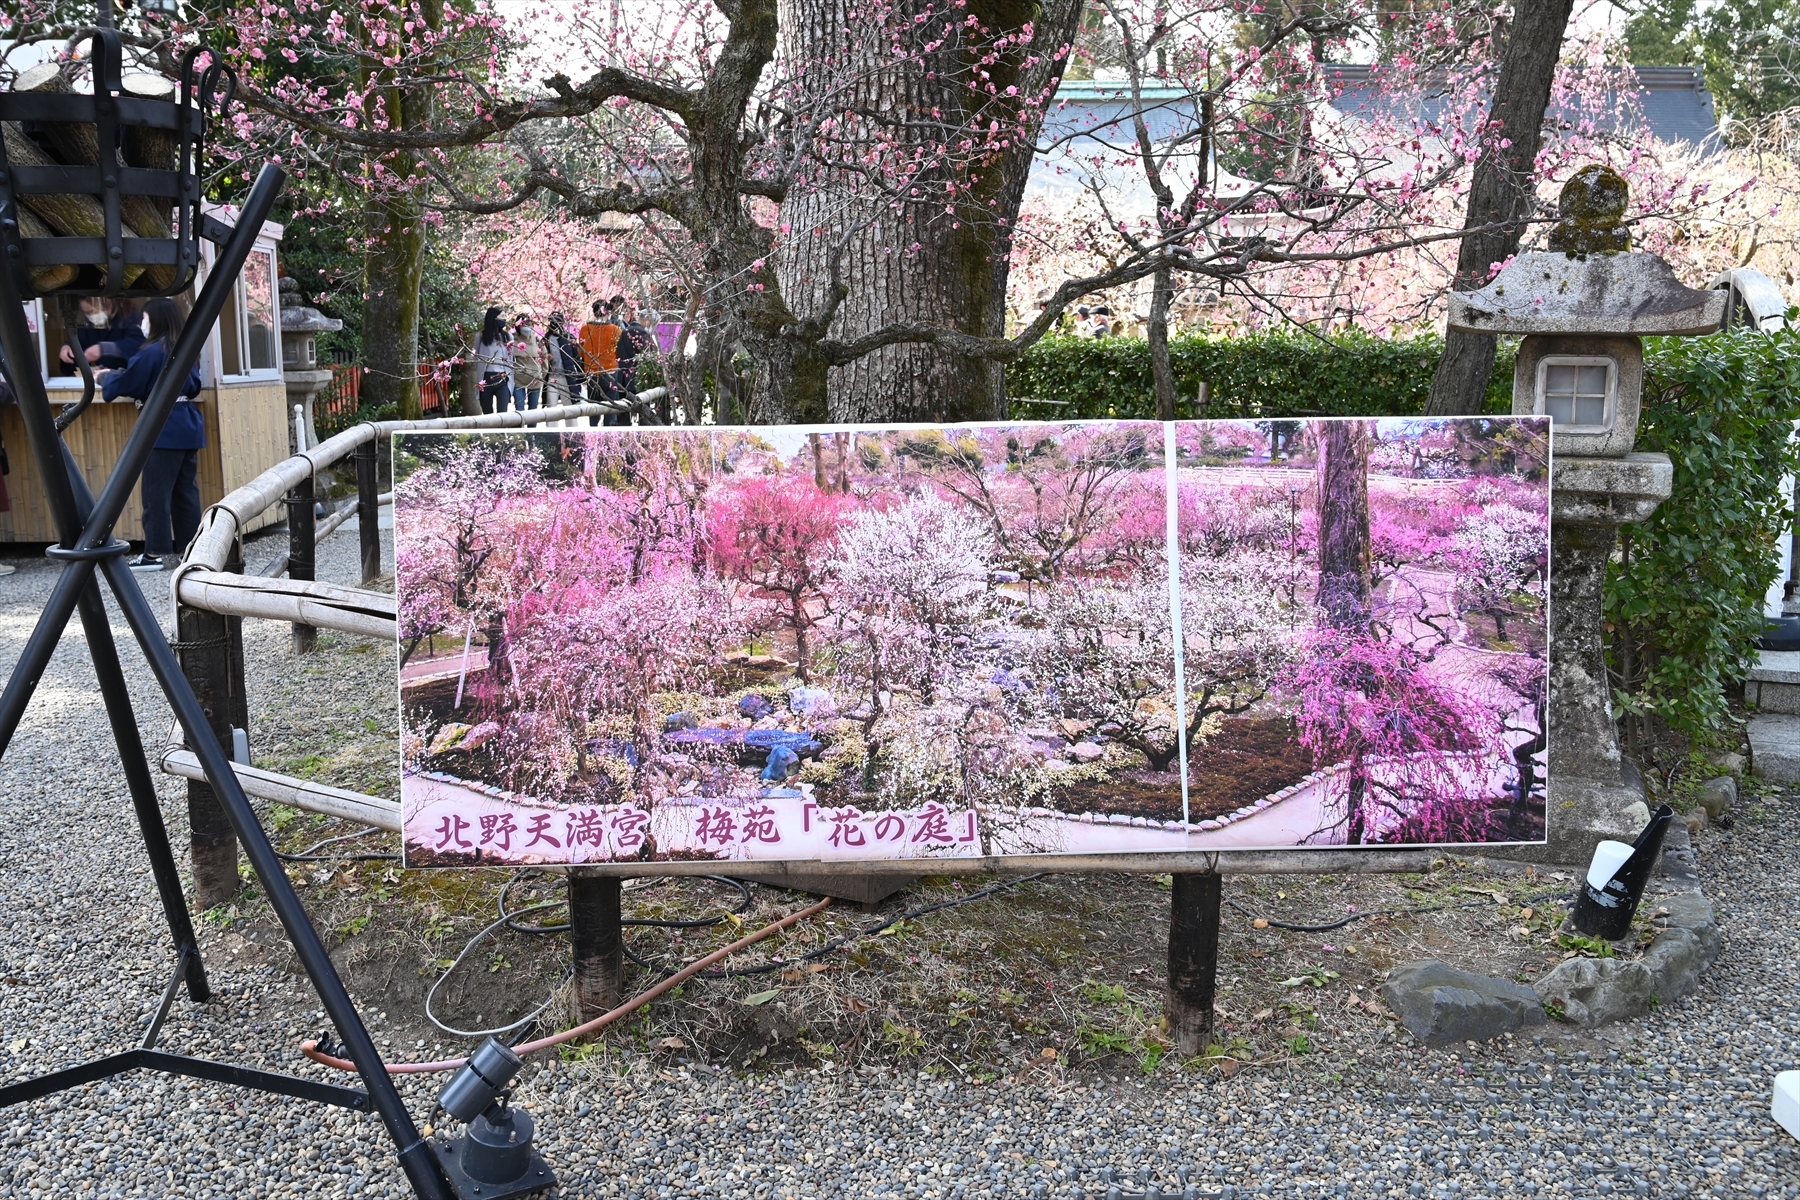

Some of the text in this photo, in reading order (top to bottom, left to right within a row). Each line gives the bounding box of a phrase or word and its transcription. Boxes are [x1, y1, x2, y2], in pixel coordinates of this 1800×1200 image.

[434, 808, 648, 851] 北野天満宮
